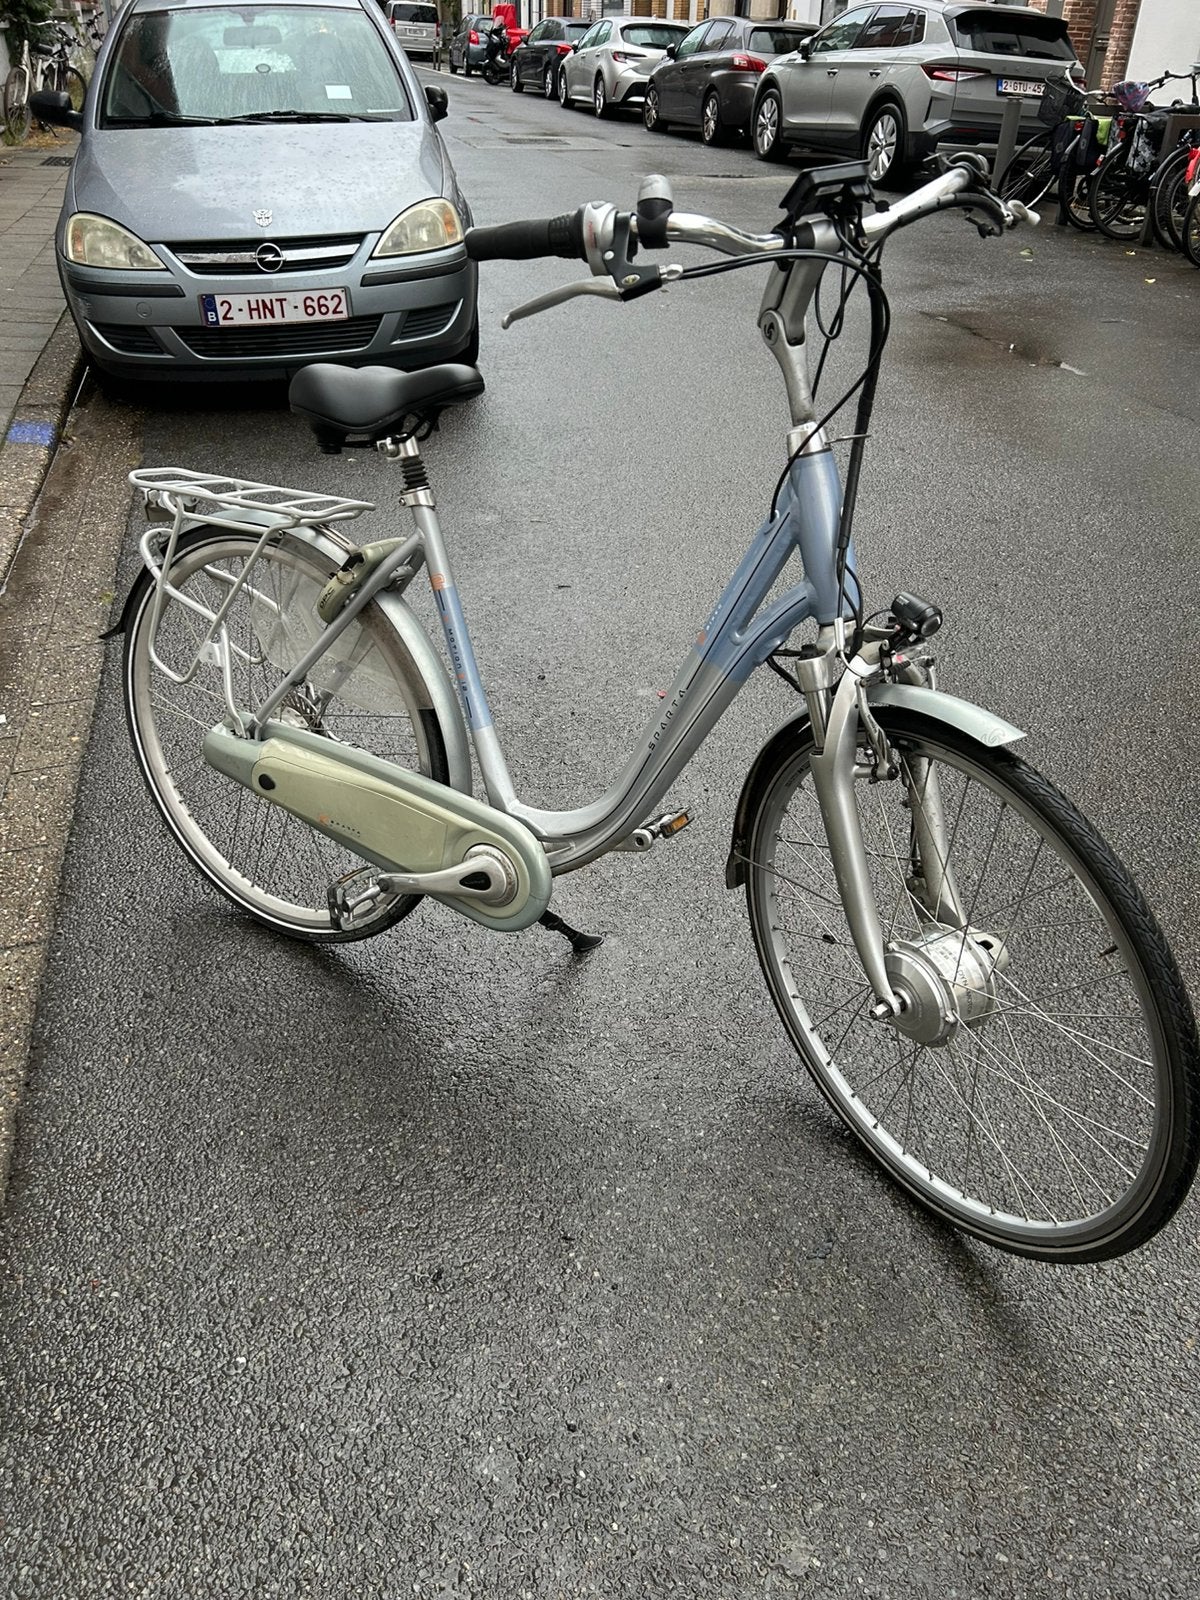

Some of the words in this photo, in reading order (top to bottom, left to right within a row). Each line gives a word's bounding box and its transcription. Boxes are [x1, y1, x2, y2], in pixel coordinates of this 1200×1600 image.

[208, 311, 217, 322] B
[220, 294, 344, 321] 2-HNT-662
[648, 689, 687, 750] SPARTA
